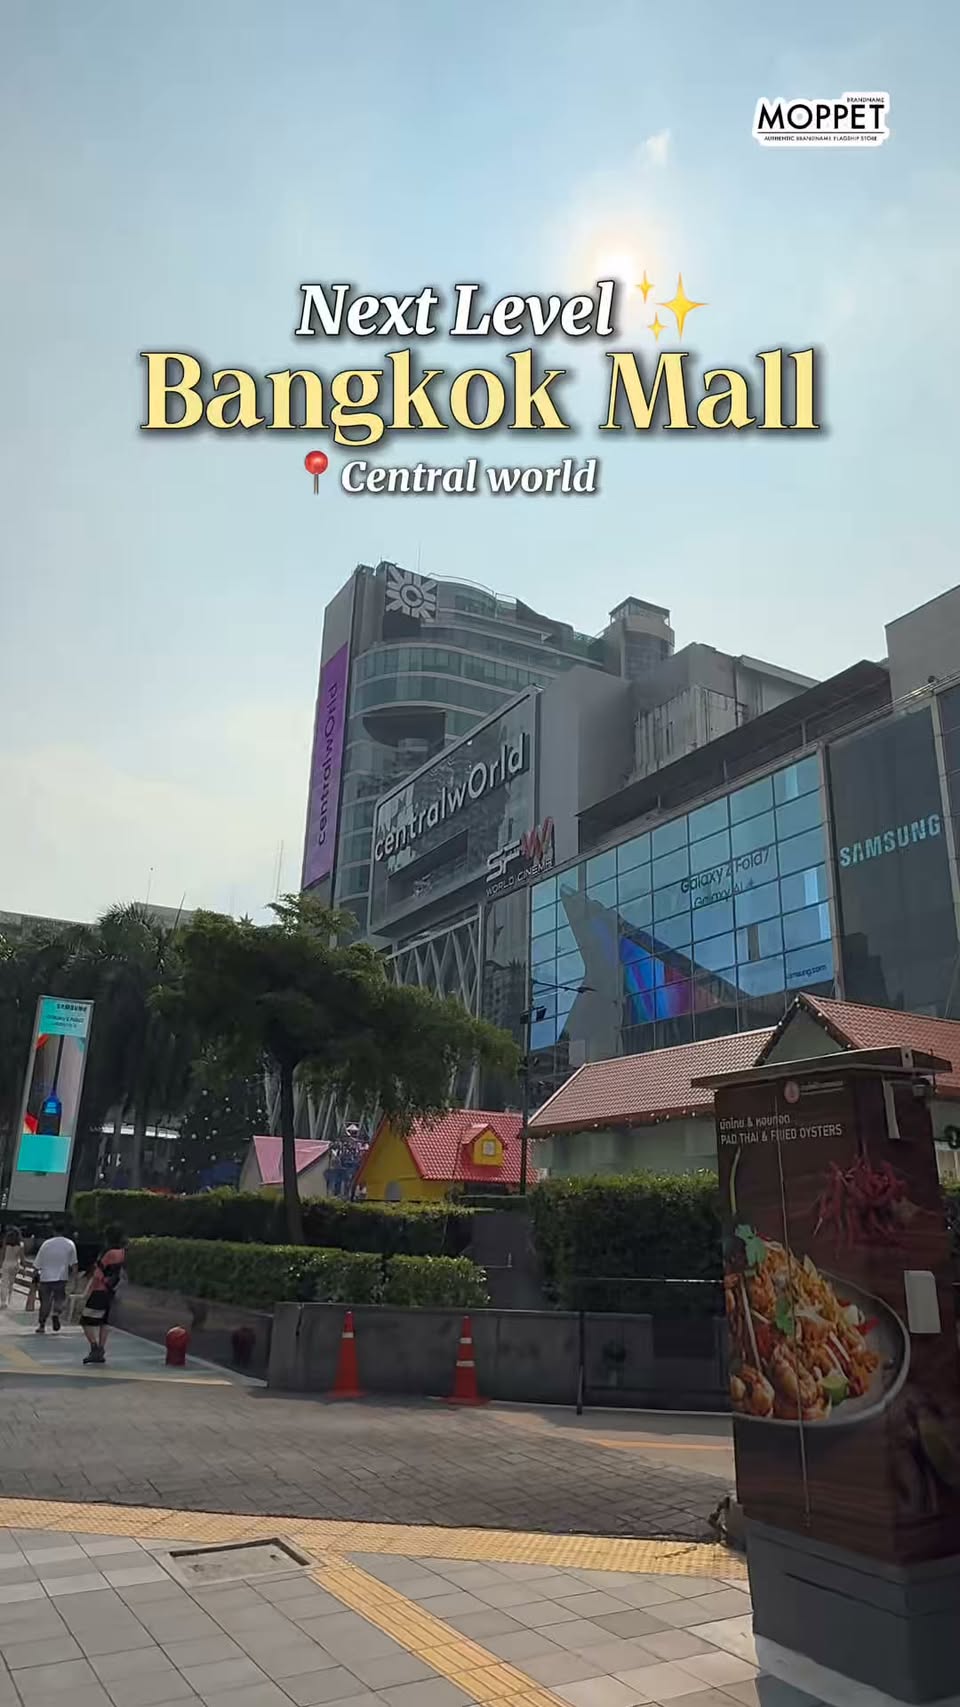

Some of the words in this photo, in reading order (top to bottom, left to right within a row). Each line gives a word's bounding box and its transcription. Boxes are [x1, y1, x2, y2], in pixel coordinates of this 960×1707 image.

[840, 814, 941, 867] SAMSUNG
[485, 876, 516, 897] WORLD
[517, 858, 553, 882] CINEMA
[680, 867, 723, 893] Galaxy
[721, 1134, 737, 1145] PAD
[739, 1132, 760, 1143] THAI
[761, 1131, 769, 1142] &
[799, 1123, 843, 1139] OYSTERS
[747, 1116, 754, 1127] &
